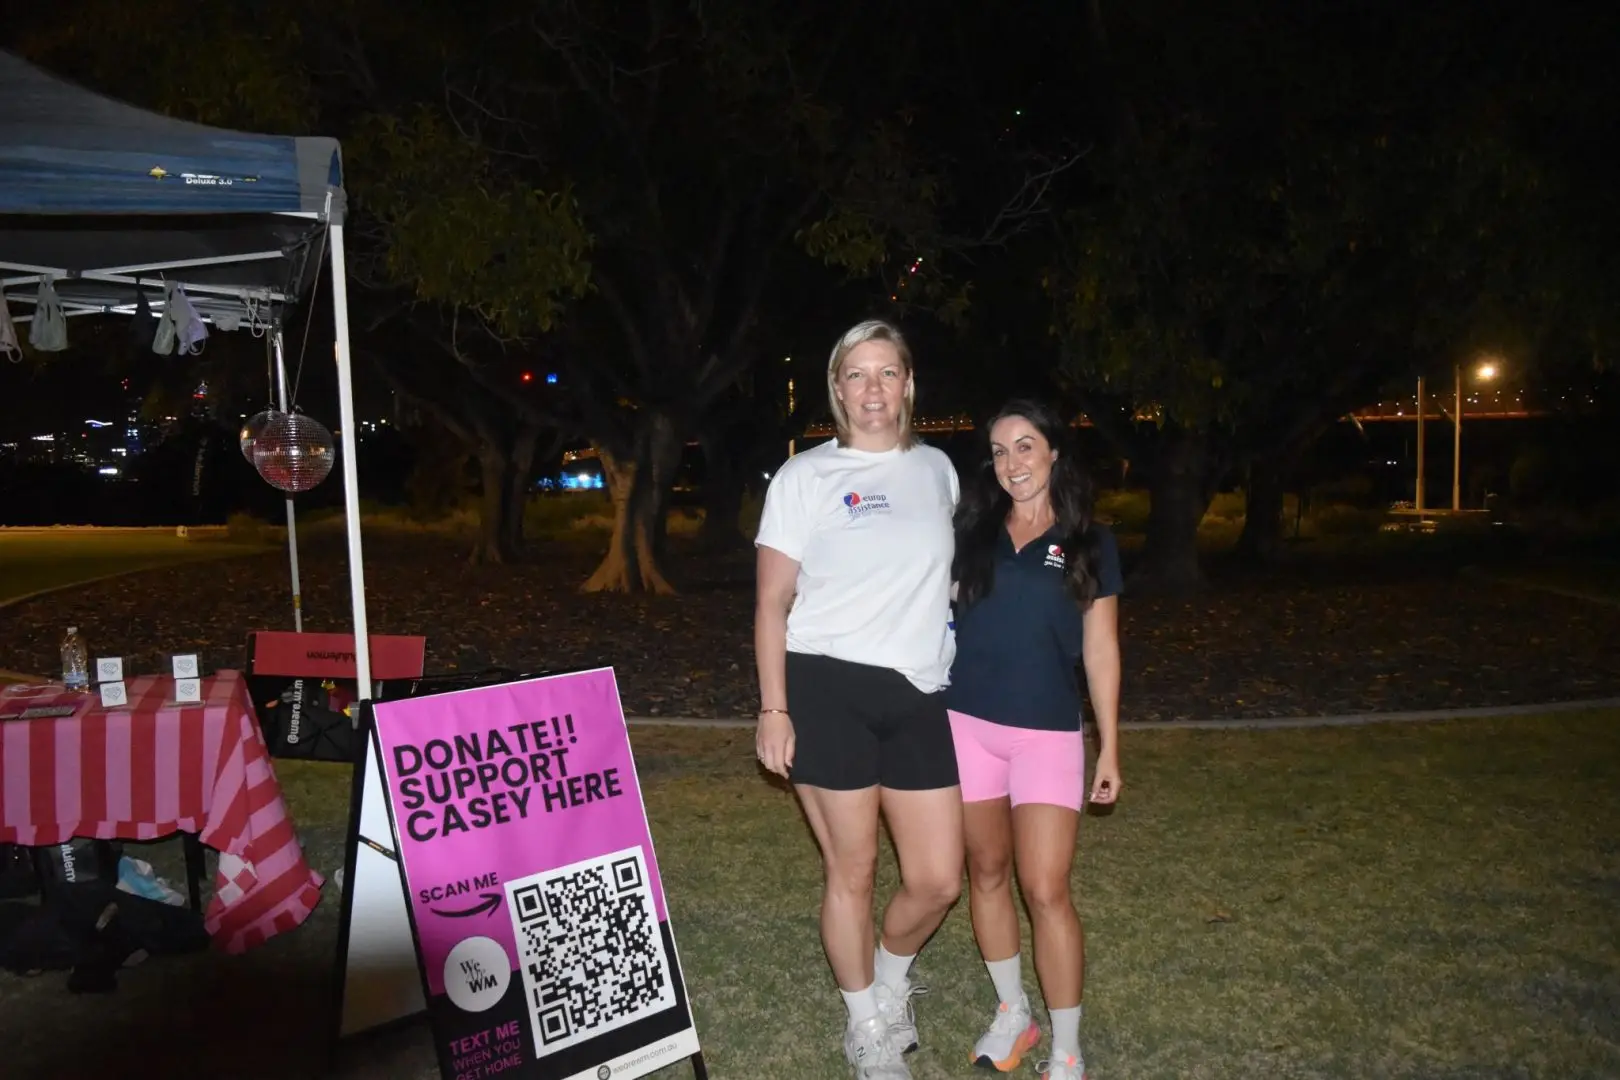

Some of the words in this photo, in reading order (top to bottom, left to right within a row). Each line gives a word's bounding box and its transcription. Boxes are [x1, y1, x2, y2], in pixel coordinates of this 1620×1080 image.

[186, 177, 217, 185] Deluxe
[848, 503, 890, 514] assistance
[862, 494, 887, 502] europ
[392, 714, 578, 777] DONATE!!
[399, 747, 570, 810] SUPPORT
[406, 787, 531, 842] CASEY
[541, 767, 623, 813] HERE
[419, 880, 470, 905] SCAN
[474, 872, 499, 890] ME
[449, 1030, 491, 1056] TEXT
[495, 1020, 520, 1041] ME
[452, 1048, 493, 1071] WHEN
[493, 1037, 521, 1056] YOU
[485, 1053, 523, 1076] HOME
